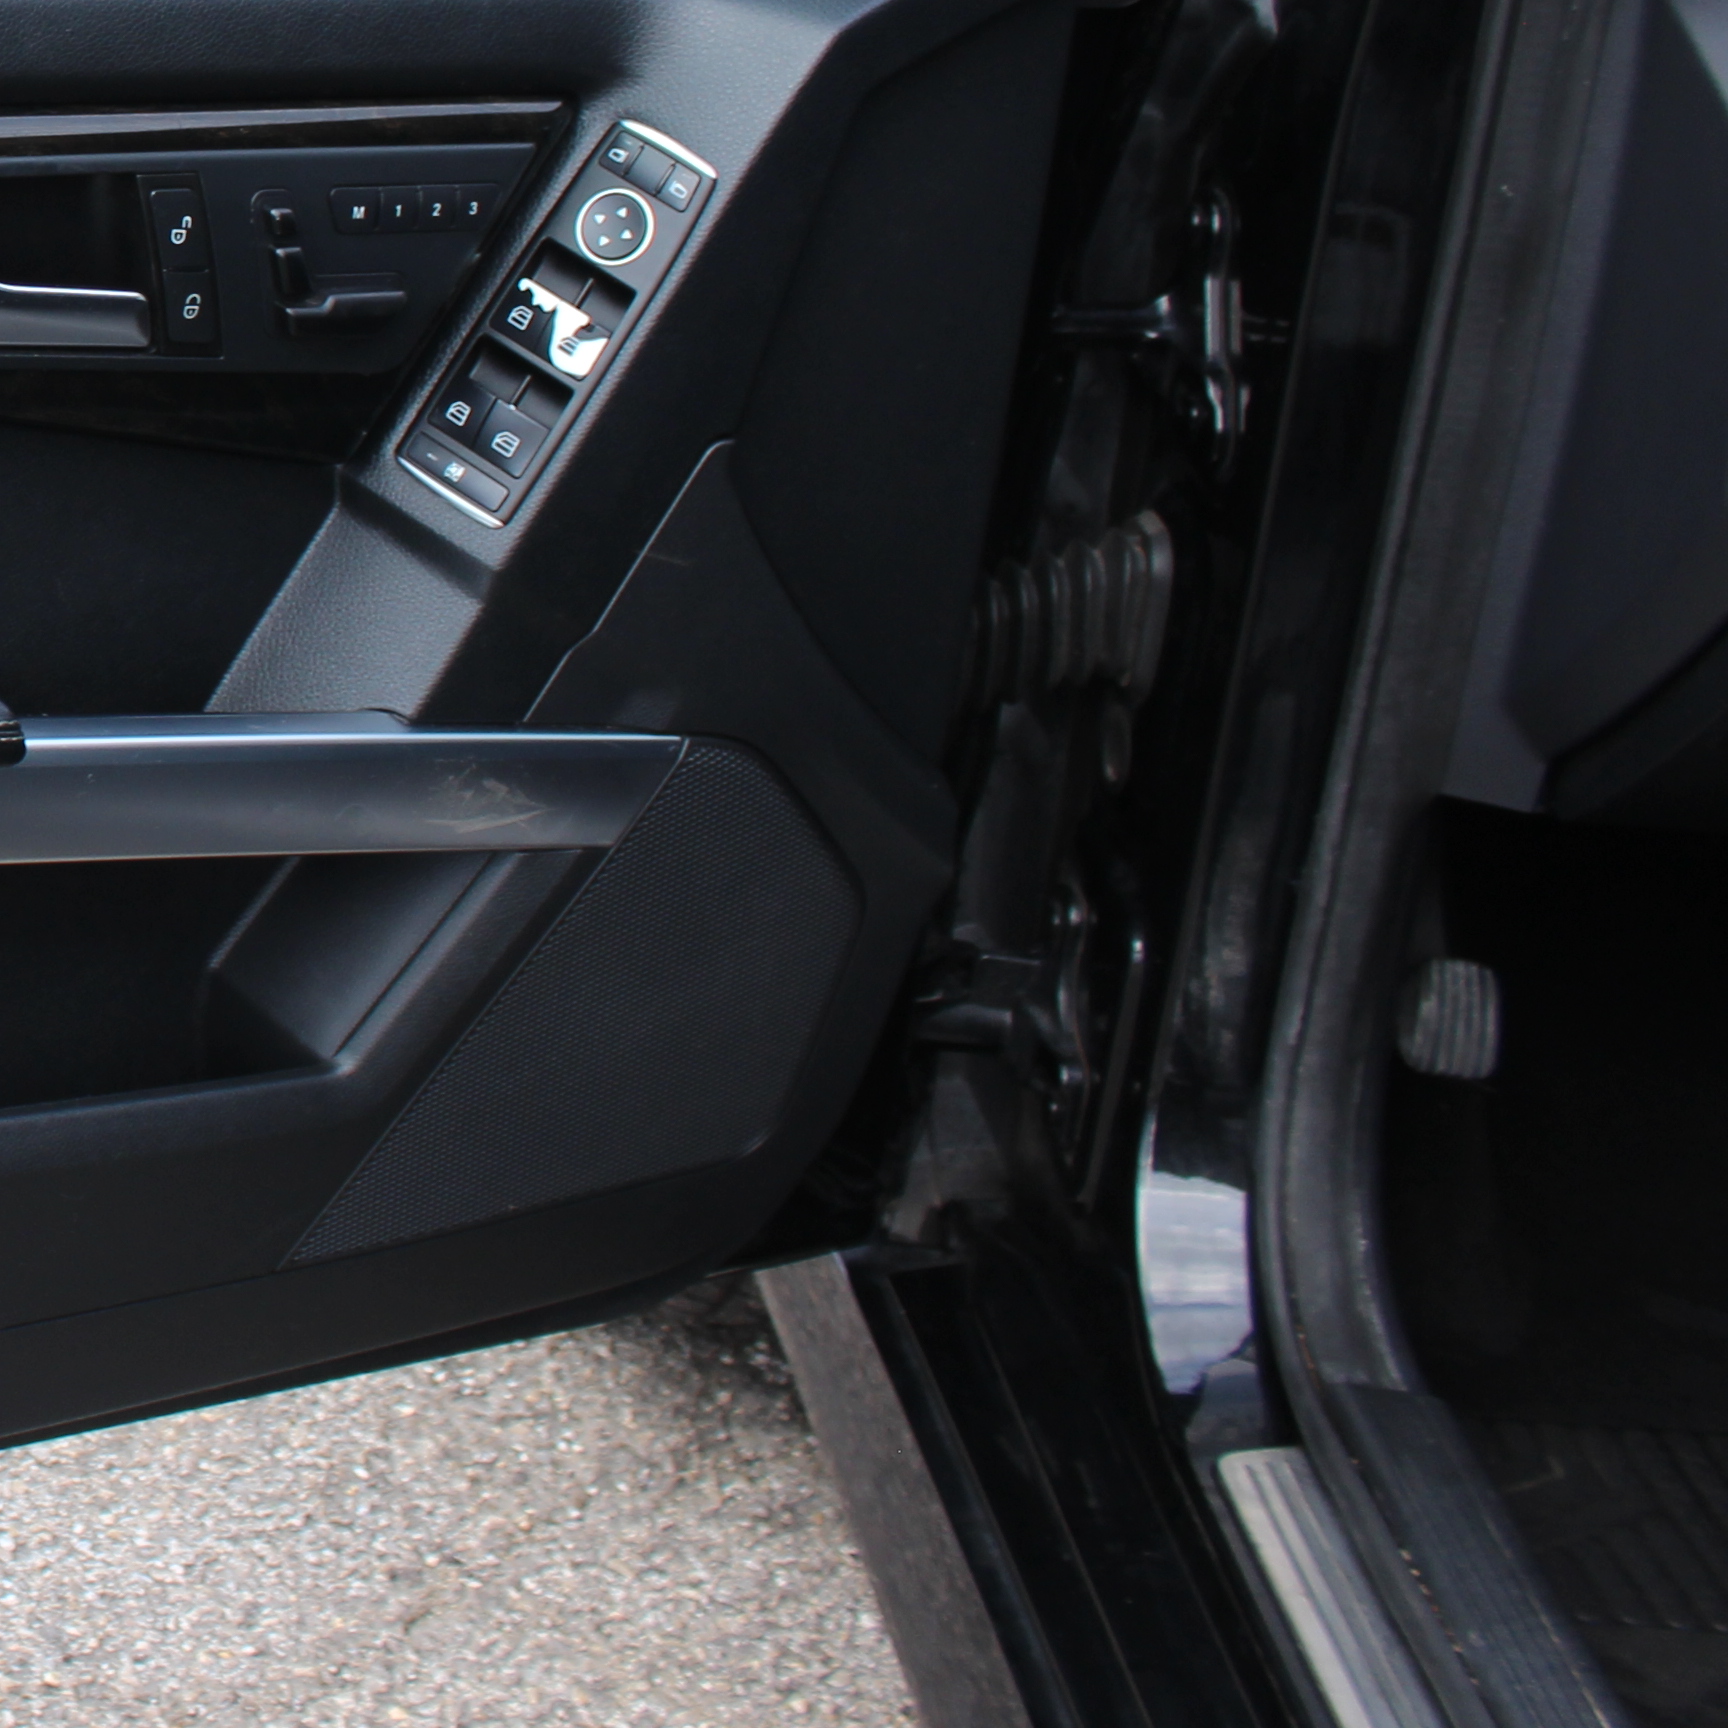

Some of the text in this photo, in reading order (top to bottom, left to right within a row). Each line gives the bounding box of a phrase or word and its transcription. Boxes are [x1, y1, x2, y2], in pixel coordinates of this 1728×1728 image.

[352, 201, 479, 220] M 1 2 3
